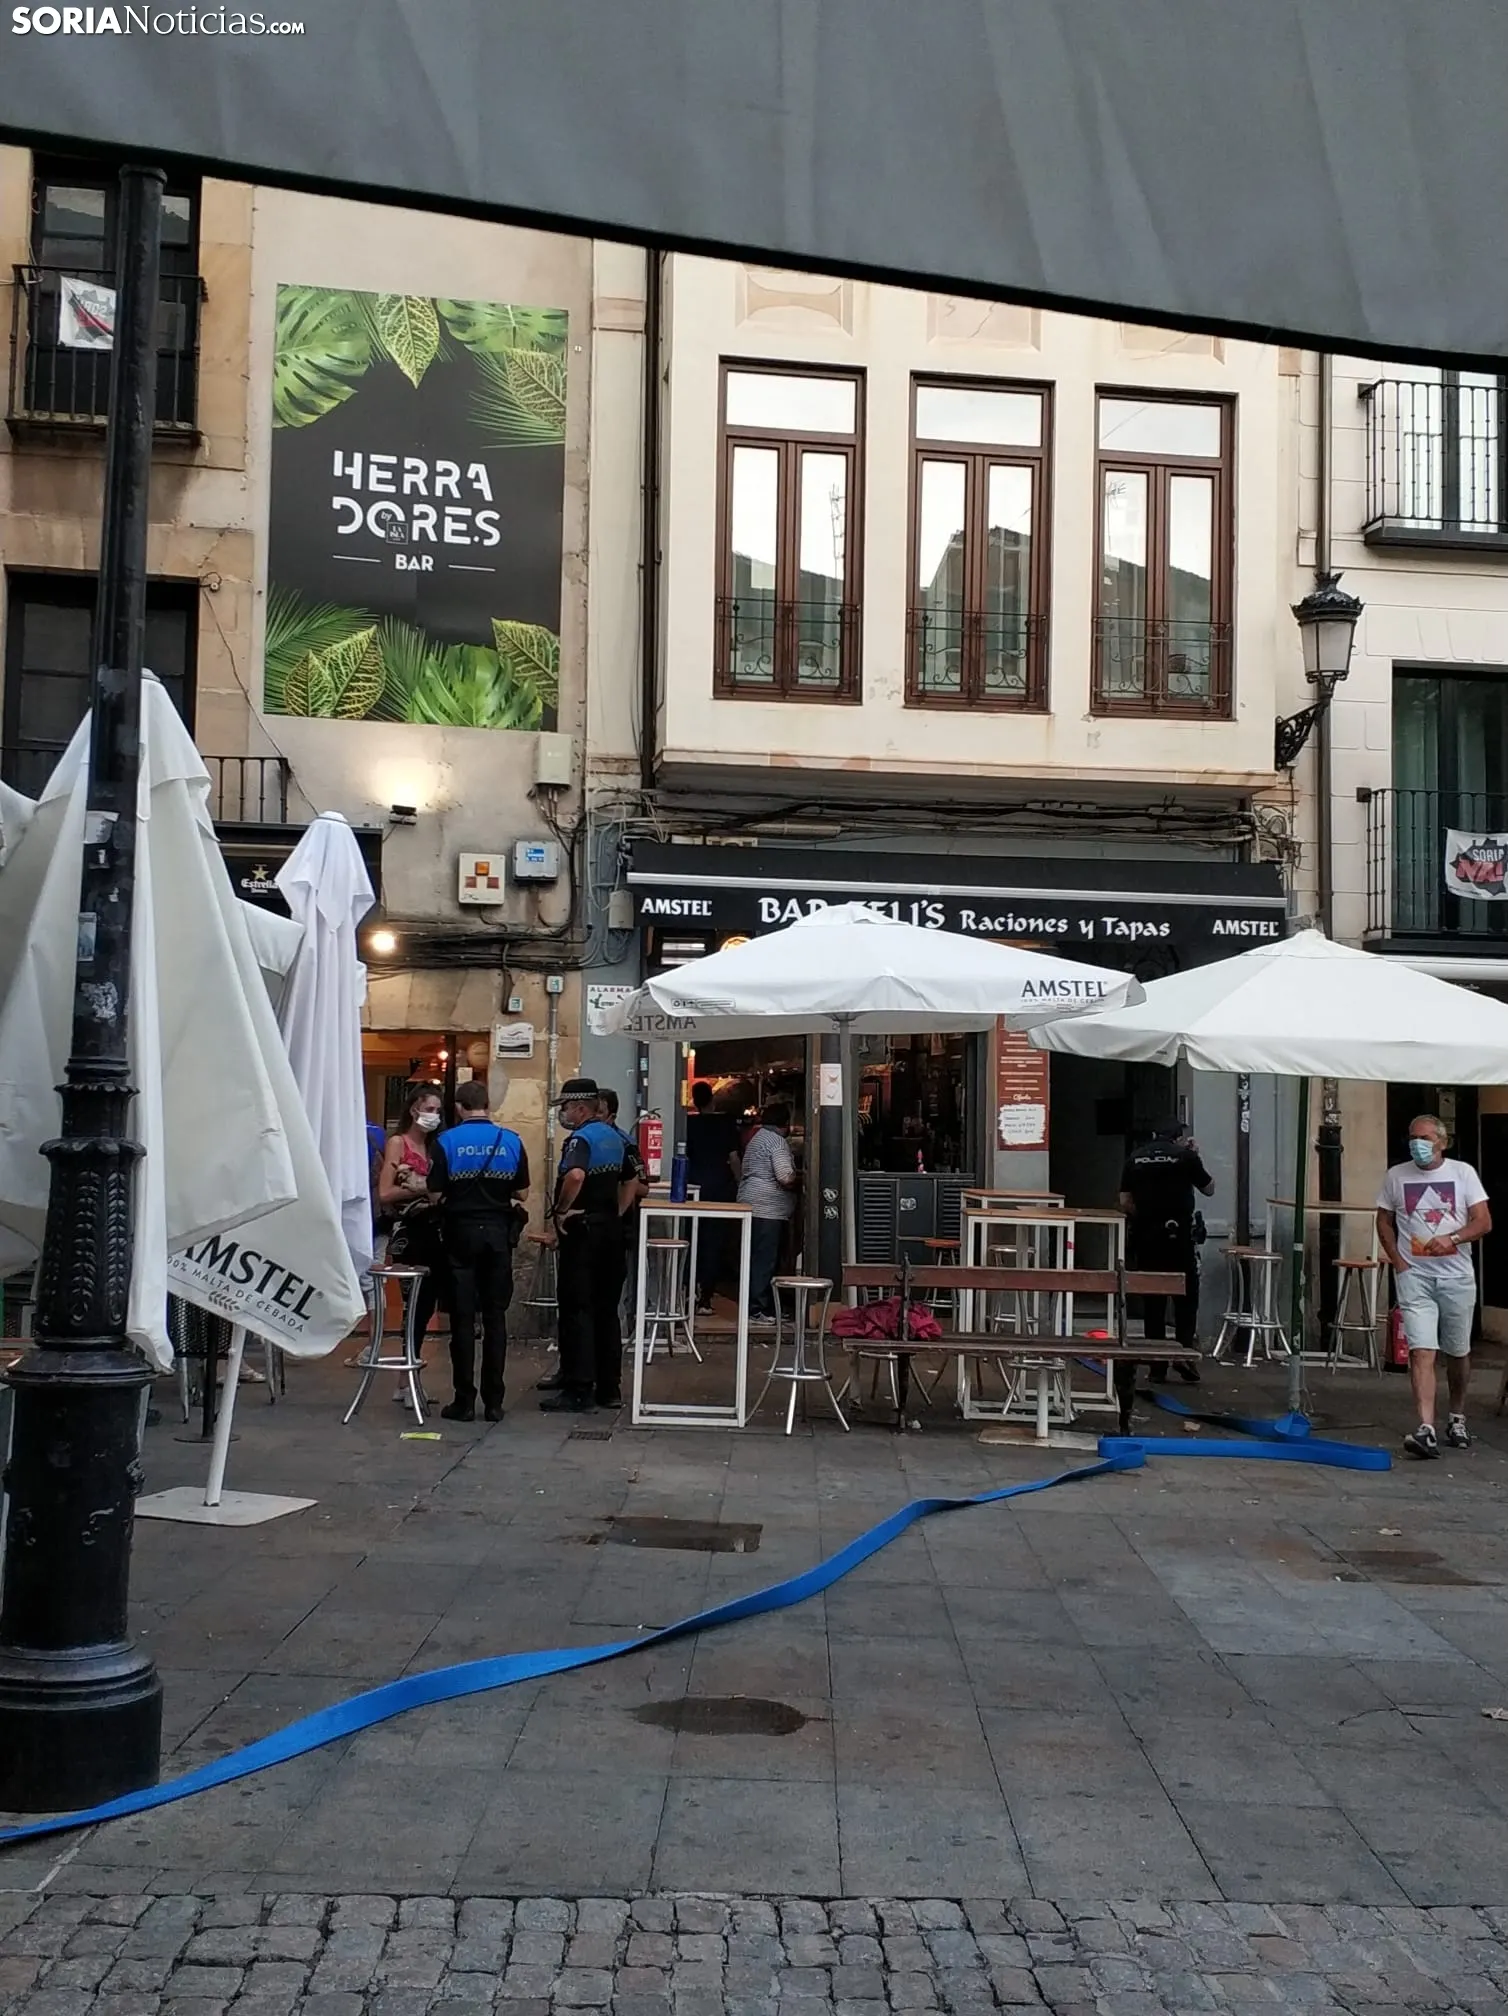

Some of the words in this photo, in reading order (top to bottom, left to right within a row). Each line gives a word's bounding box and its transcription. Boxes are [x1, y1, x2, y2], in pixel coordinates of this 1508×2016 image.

[333, 450, 494, 501] HERRA
[332, 496, 501, 547] DORES
[395, 554, 434, 572] BAR
[640, 898, 712, 916] AMSTEL
[959, 909, 1069, 933] Raciones
[1078, 919, 1094, 940] y
[1100, 916, 1171, 941] Tapas
[1212, 919, 1279, 937] AMSTEL
[1021, 980, 1107, 998] AMSTEL
[192, 1269, 231, 1293] MALTA
[236, 1290, 253, 1304] DE
[256, 1300, 305, 1333] CEBADA
